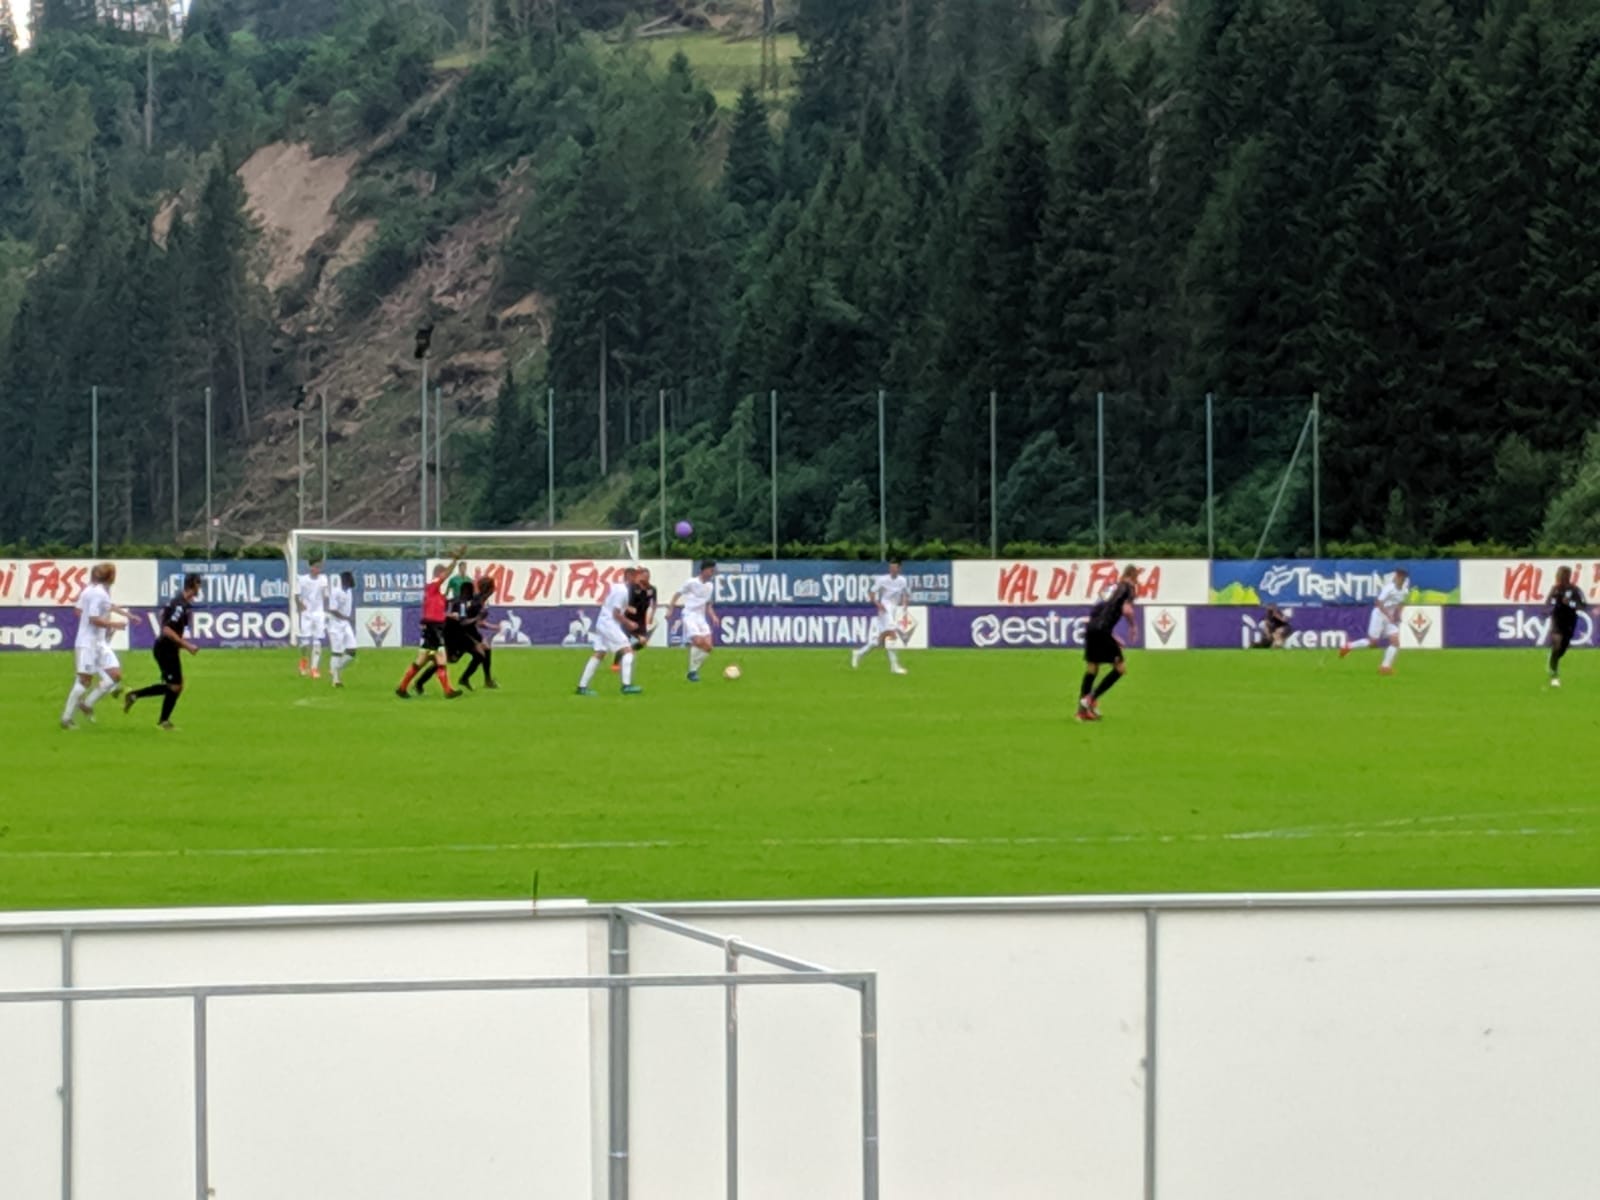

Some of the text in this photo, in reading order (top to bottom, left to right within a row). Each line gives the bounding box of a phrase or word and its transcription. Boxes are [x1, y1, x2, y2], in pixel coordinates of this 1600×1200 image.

[24, 562, 88, 604] FASS
[170, 573, 261, 603] FSTIVAL
[565, 560, 630, 603] FAS
[714, 573, 793, 602] ESTIVAL
[998, 563, 1038, 603] VAL
[1086, 562, 1160, 600] FAA
[1296, 567, 1398, 600] TRENTIN
[1504, 563, 1544, 602] VAL
[147, 611, 312, 640] VRGRO
[721, 615, 880, 643] SAMMONTANA
[1002, 611, 1089, 645] estra
[1498, 609, 1552, 646] sky
